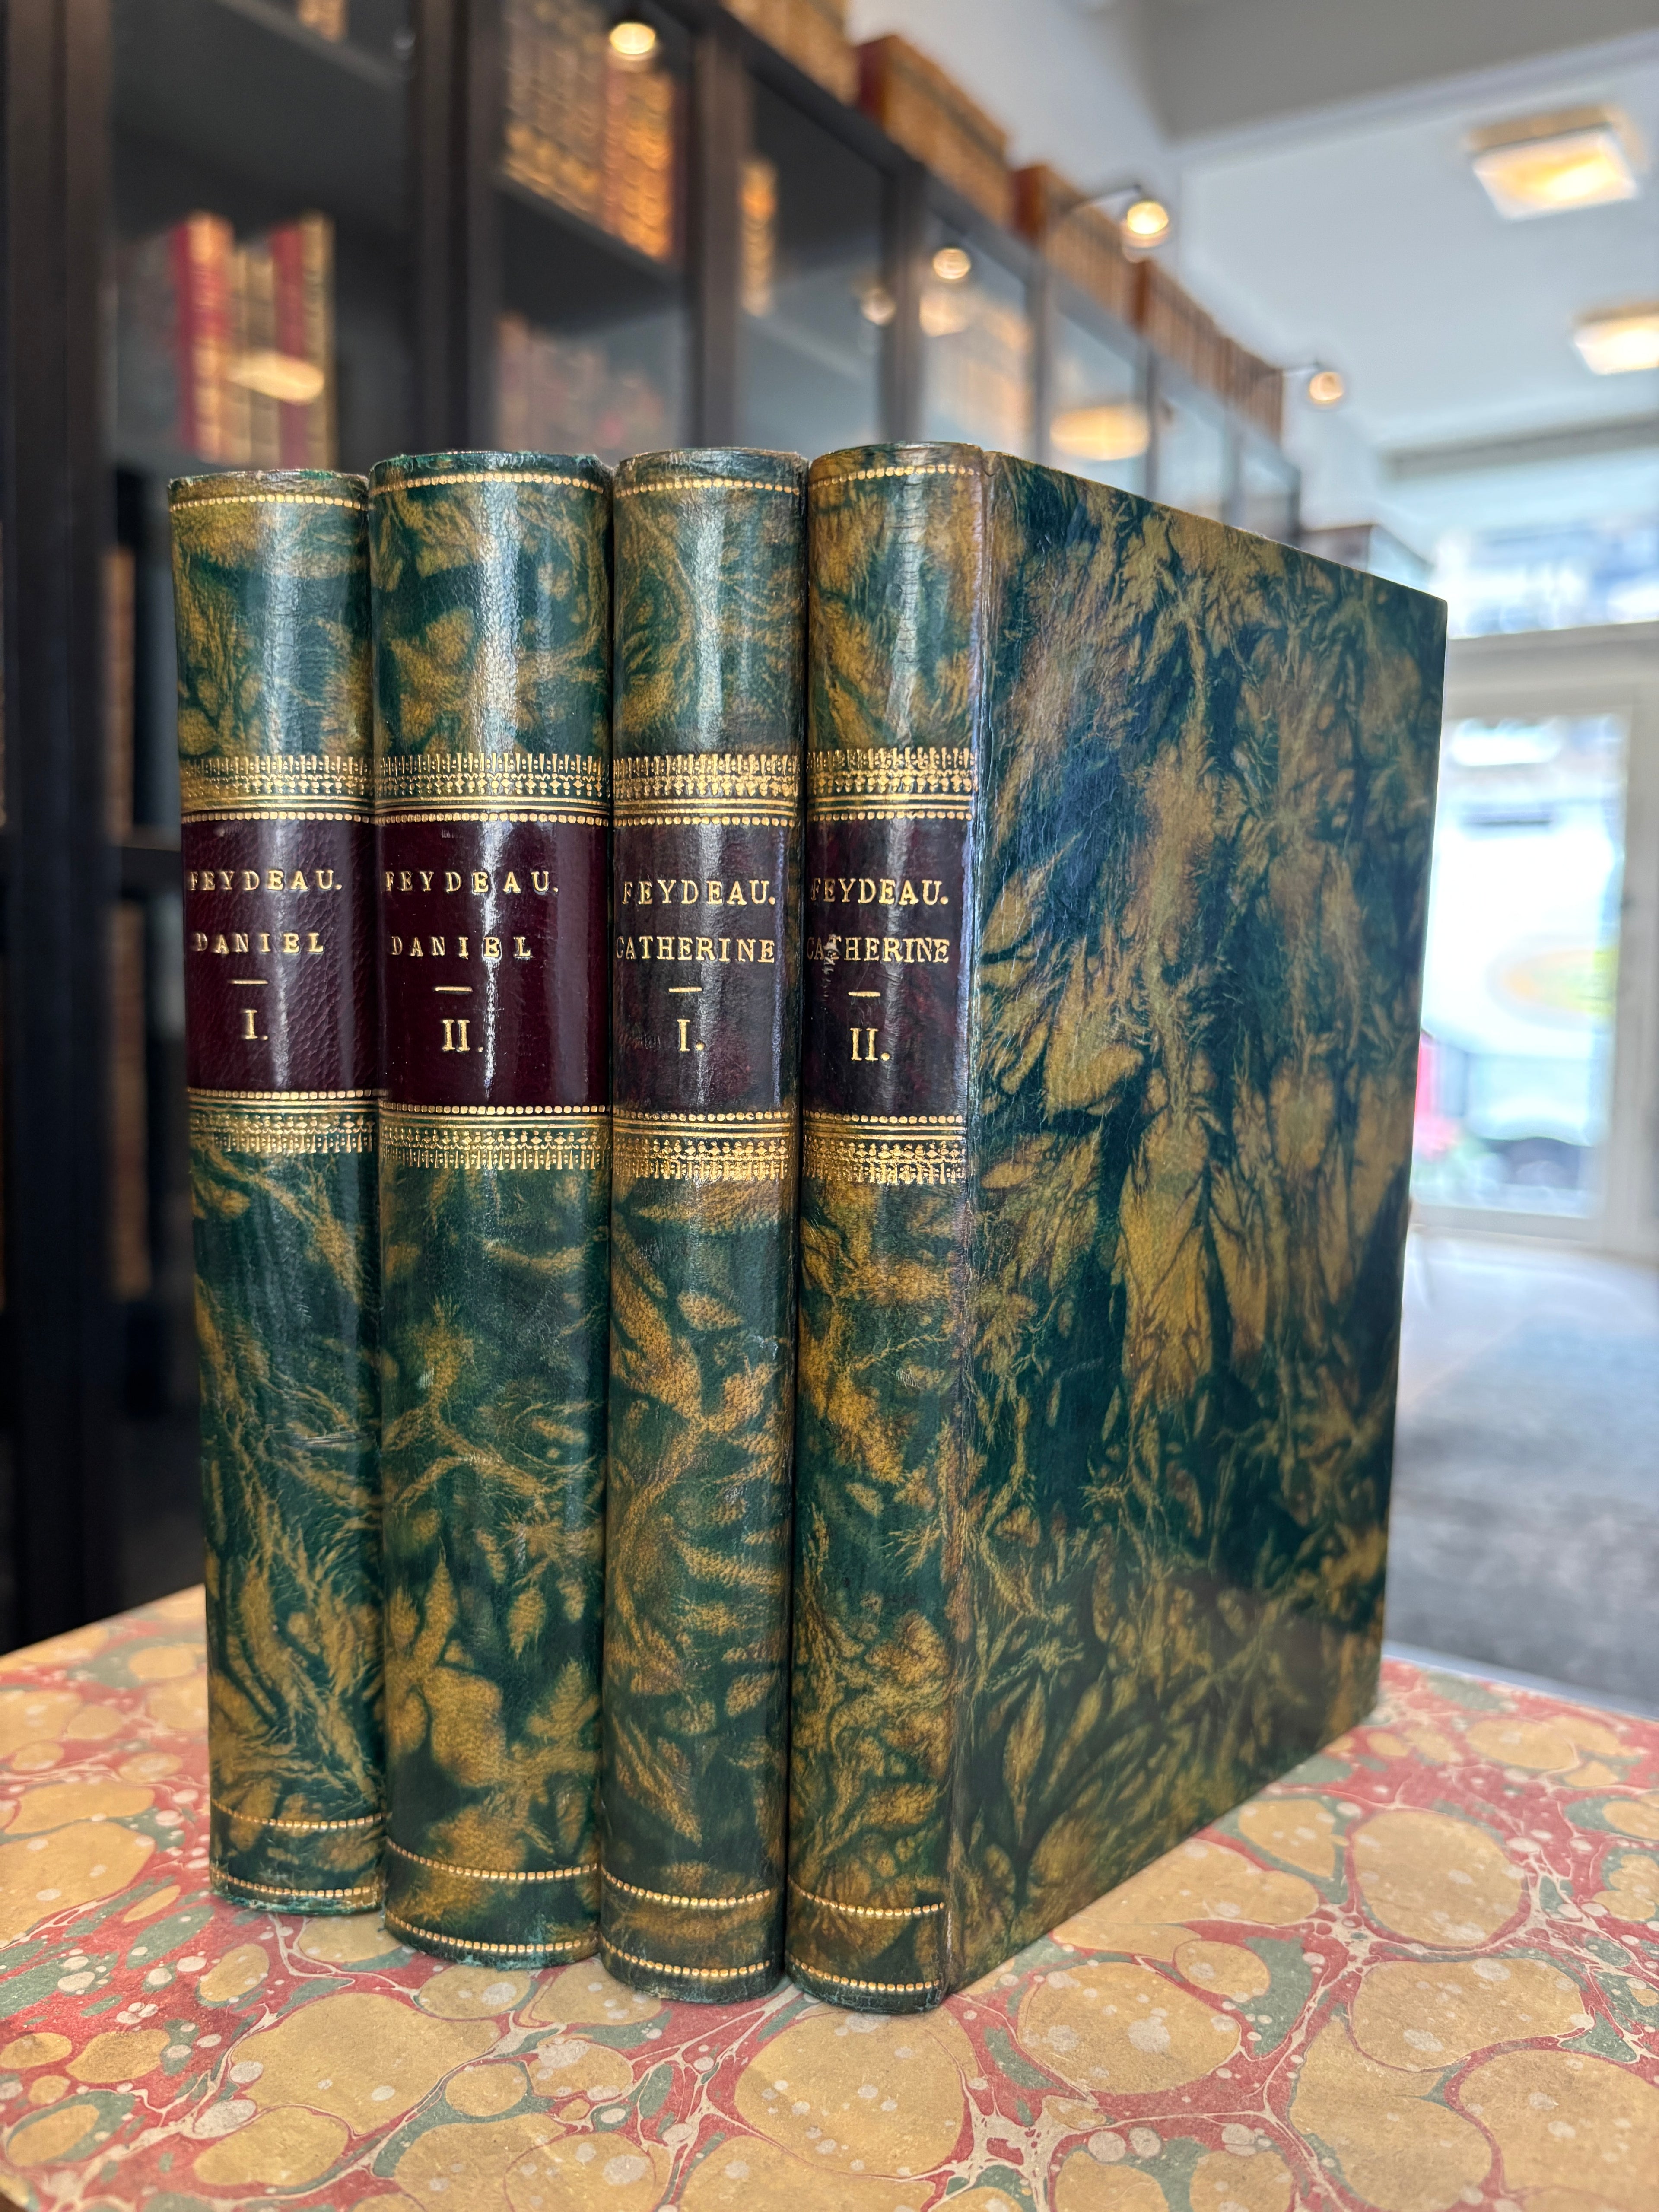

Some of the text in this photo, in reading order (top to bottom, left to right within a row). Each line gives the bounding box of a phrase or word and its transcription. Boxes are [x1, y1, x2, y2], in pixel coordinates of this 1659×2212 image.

[187, 870, 342, 890] FEYDEAU.
[385, 871, 559, 893] FEYDEAU.
[622, 880, 776, 905] FEYDEAU.
[811, 878, 949, 905] FEYDEAU.
[193, 932, 324, 954] DANIEL
[391, 936, 532, 958] DANIEL
[616, 936, 775, 963] CATHERINE
[807, 936, 950, 963] CATHERINE
[242, 1009, 268, 1040] I.
[442, 1019, 484, 1052] II.
[677, 1019, 705, 1052] I.
[850, 1027, 890, 1061] II.
